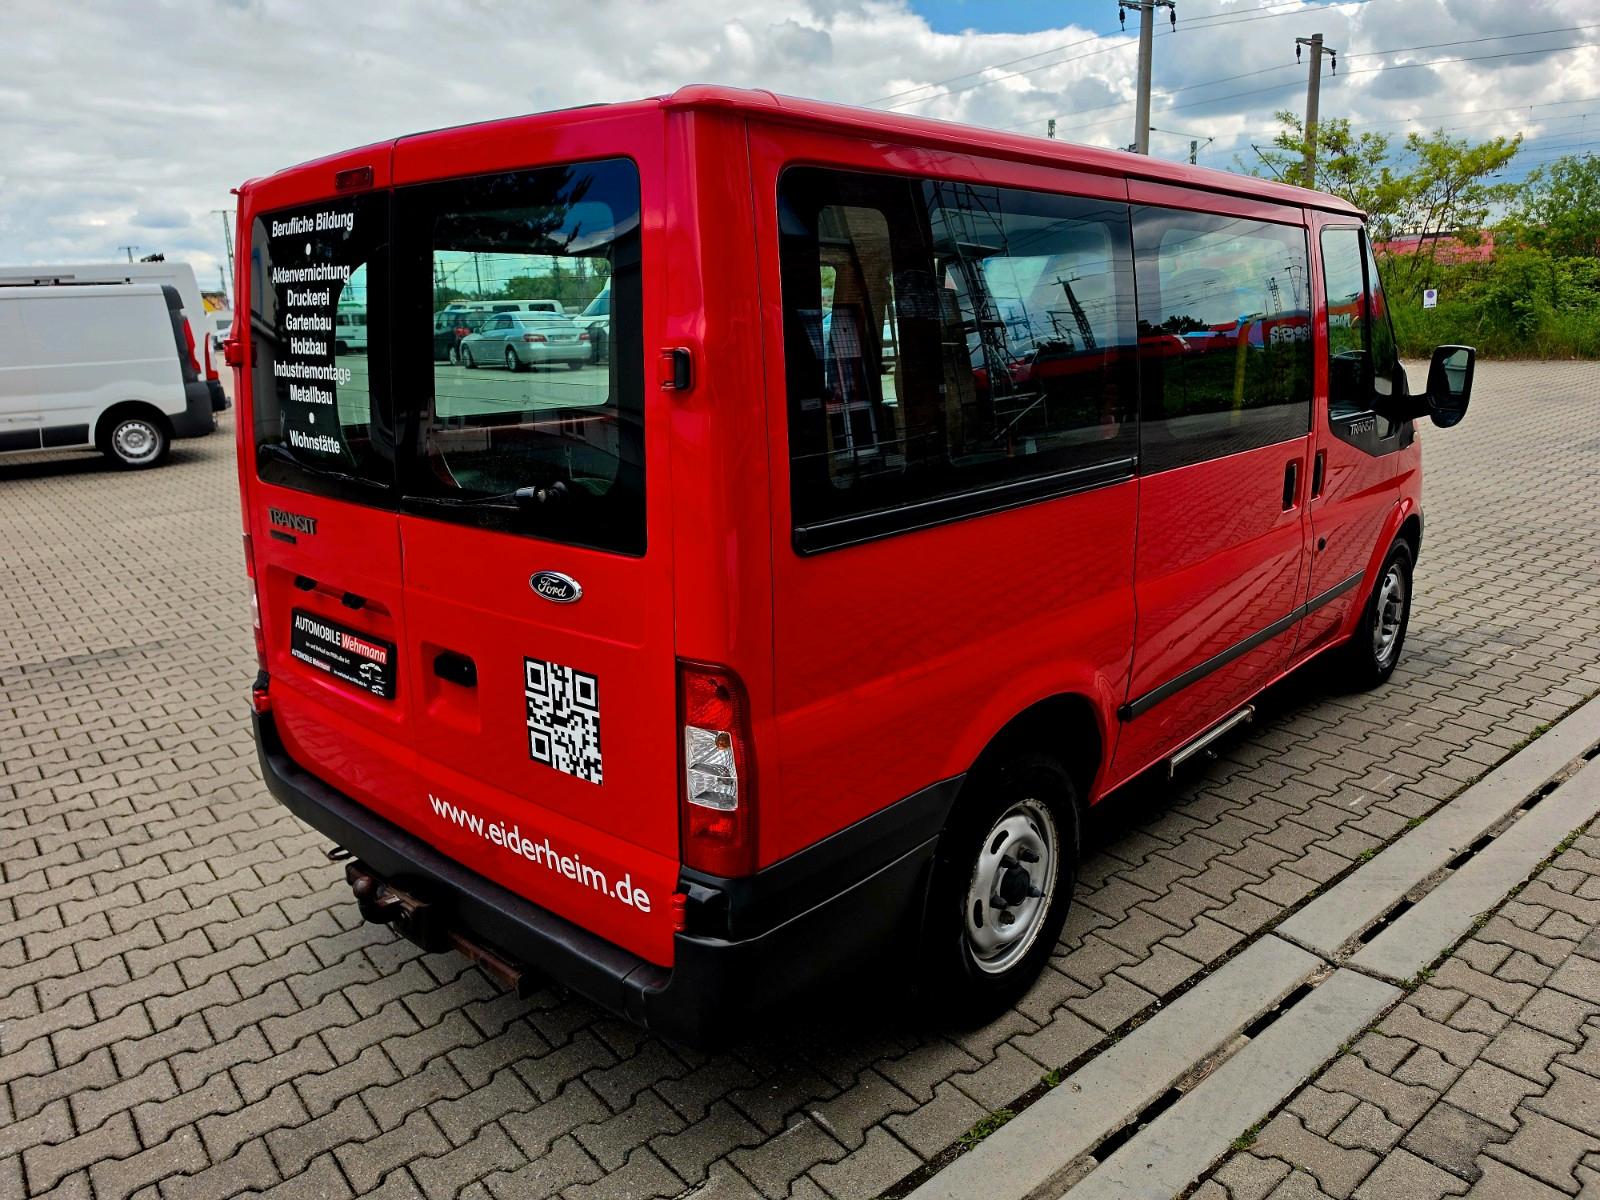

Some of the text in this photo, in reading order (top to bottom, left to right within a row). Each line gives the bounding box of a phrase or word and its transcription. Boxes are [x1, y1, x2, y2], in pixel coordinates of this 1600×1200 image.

[272, 211, 354, 237] Berufliche Bildung
[272, 264, 350, 284] Aktenvernichtung
[287, 288, 330, 307] Druckerei
[285, 313, 332, 331] Gartenbau
[290, 337, 327, 356] Holzbau
[274, 360, 351, 386] Industriemontage
[289, 384, 333, 405] Metallbau
[1350, 419, 1375, 436] TRANSIT
[289, 429, 341, 454] Wohnstätte
[270, 508, 317, 534] TRANSIT
[537, 576, 568, 599] Ford
[295, 615, 341, 646] AUTOMOBILE
[341, 634, 387, 664] Wehrmann
[428, 793, 651, 914] www.eiderheim.de
